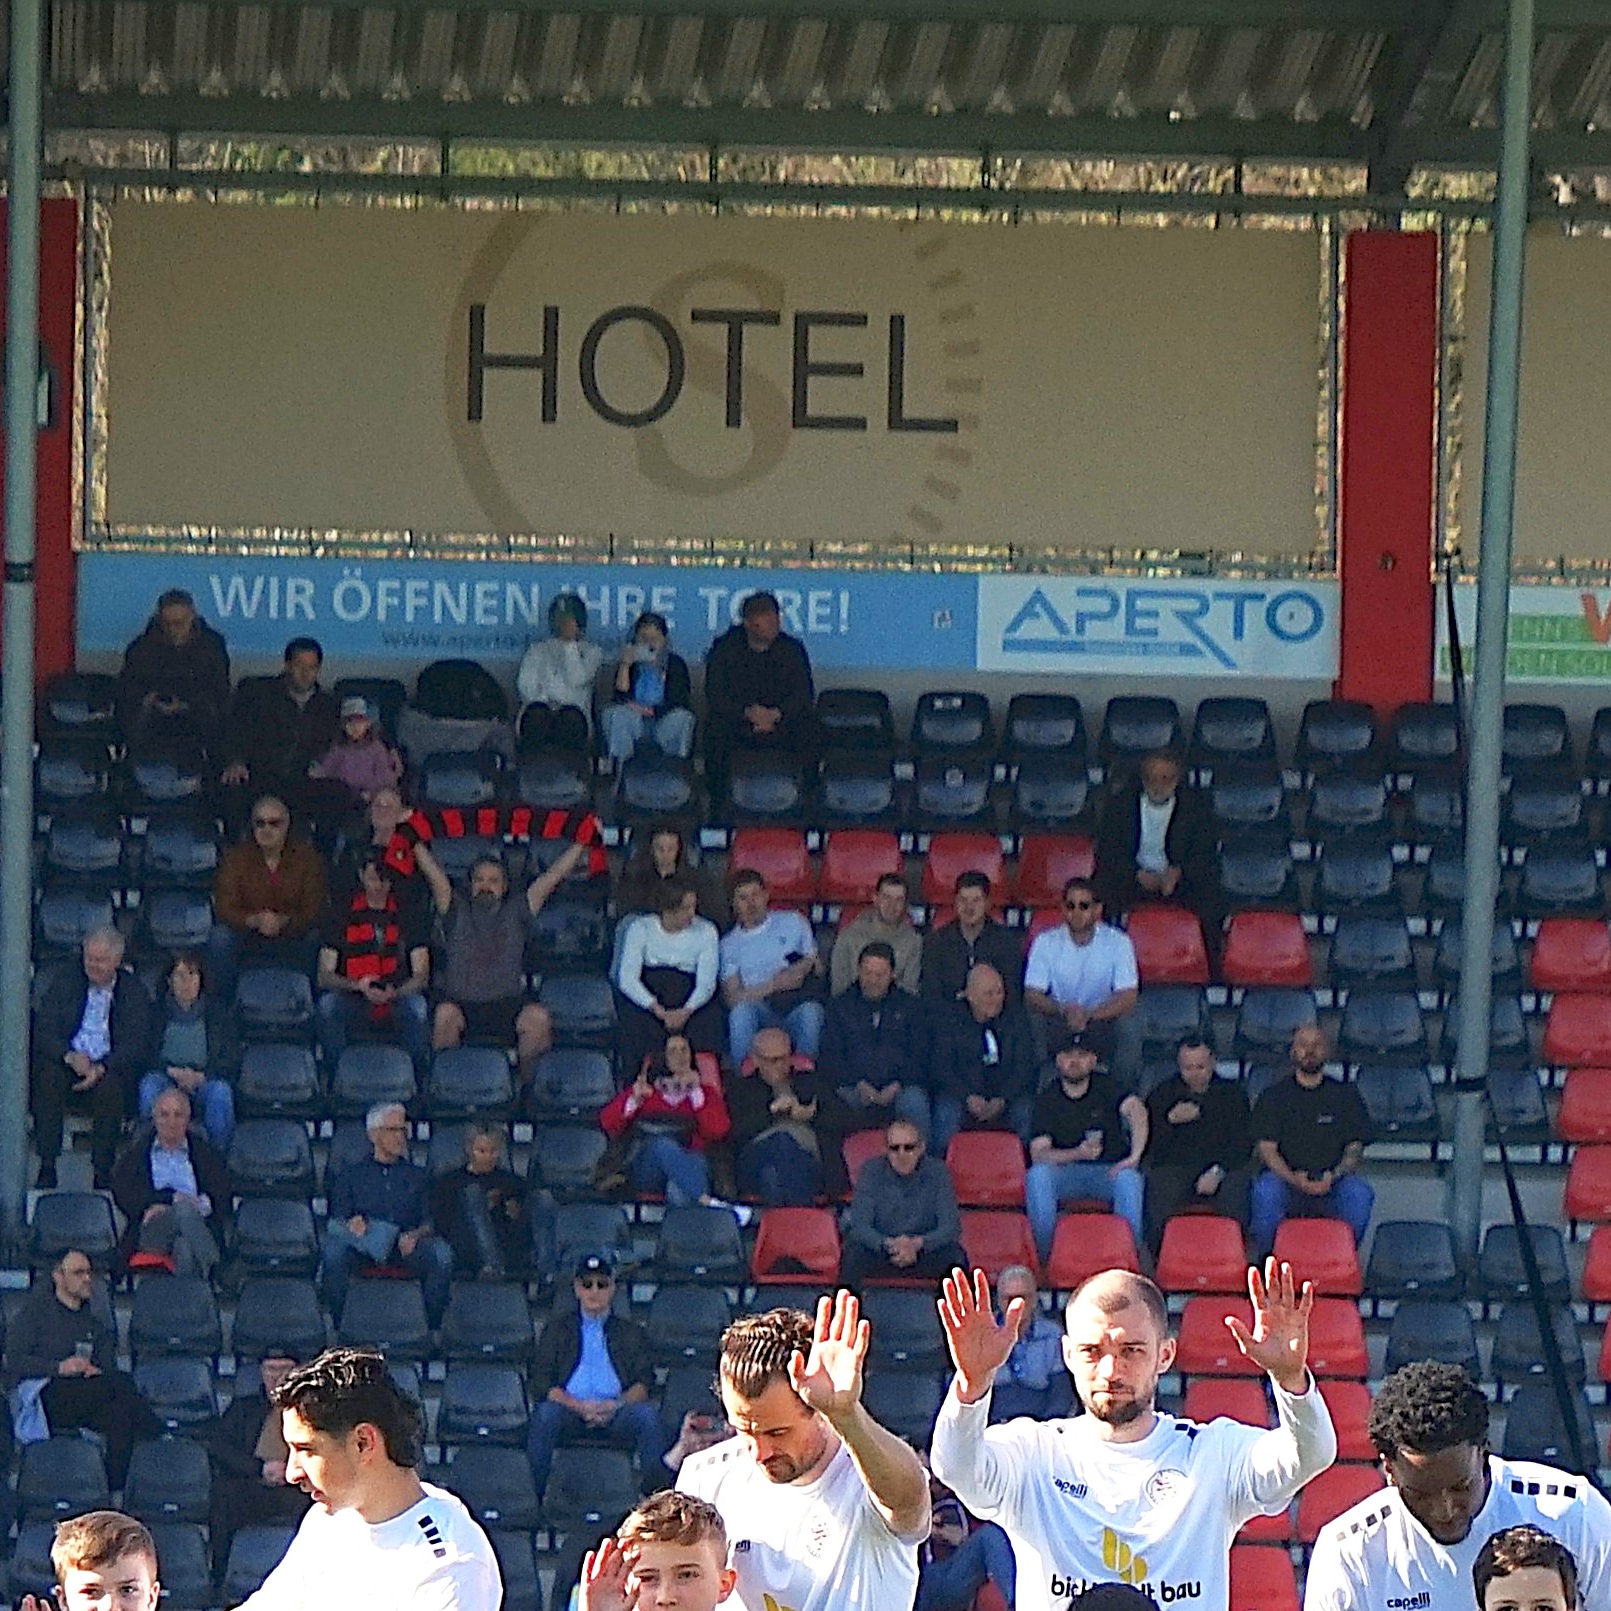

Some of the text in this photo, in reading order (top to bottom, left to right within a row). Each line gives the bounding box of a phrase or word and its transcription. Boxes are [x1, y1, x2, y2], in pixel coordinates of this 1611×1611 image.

[466, 303, 958, 433] HOTEL
[209, 573, 316, 621] WIR
[332, 566, 541, 628] ÖFFNEN
[1003, 586, 1326, 669] APERTO
[1160, 1580, 1201, 1602] bau
[1386, 1591, 1431, 1610] capelli
